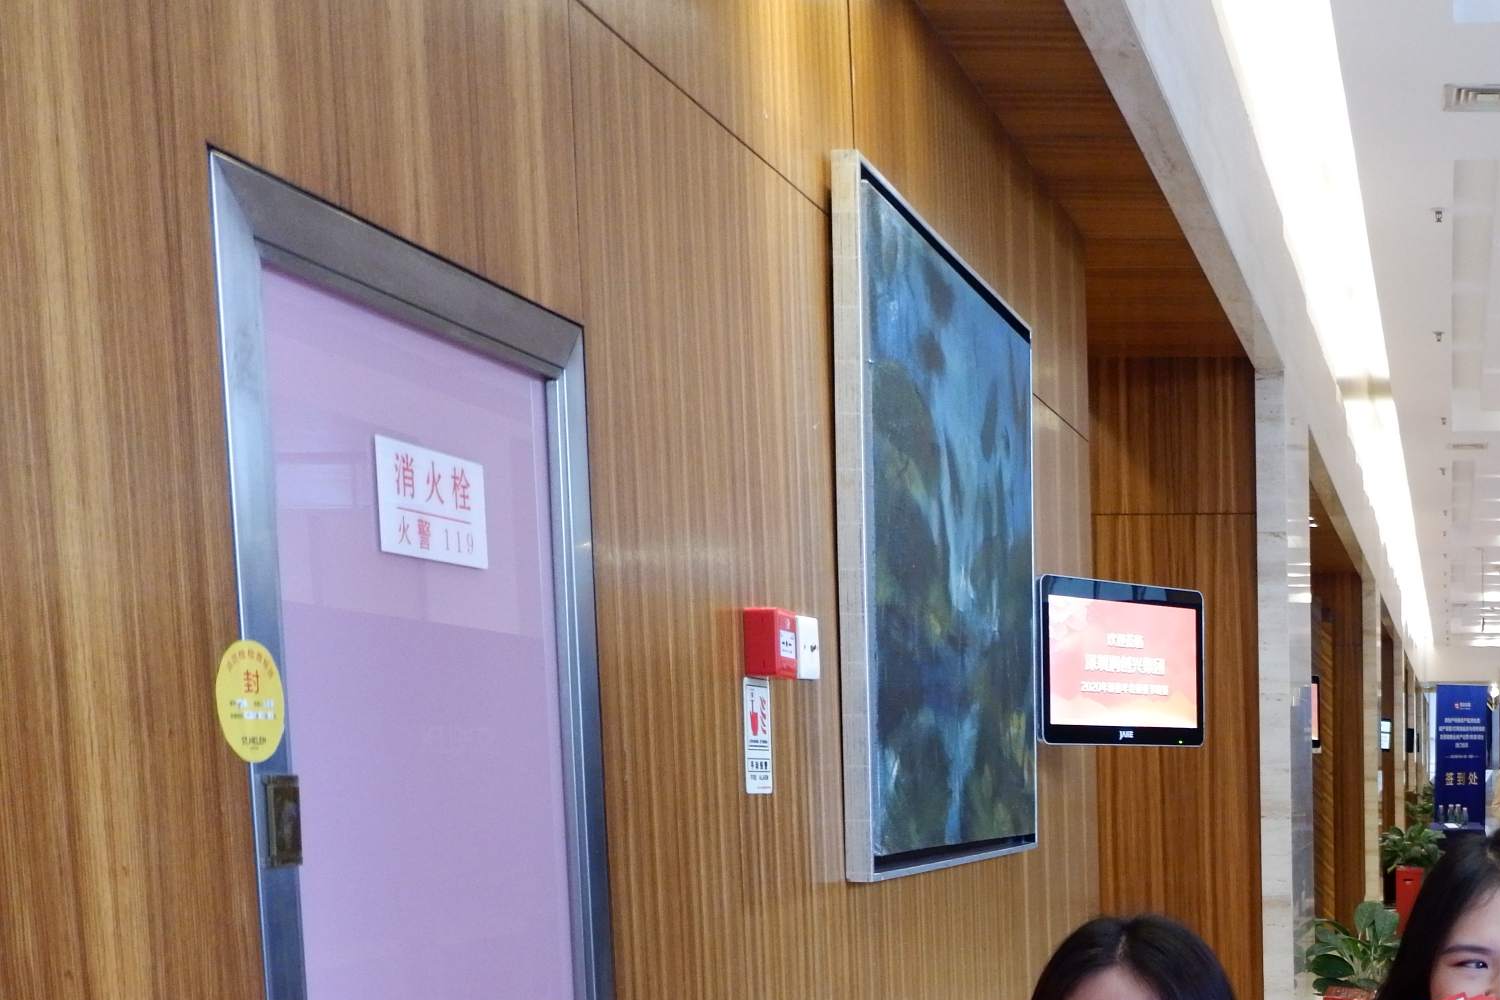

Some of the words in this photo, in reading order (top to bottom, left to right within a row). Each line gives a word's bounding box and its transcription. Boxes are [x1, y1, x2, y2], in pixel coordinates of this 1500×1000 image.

[394, 452, 471, 511] 消火栓
[398, 515, 431, 550] 火警
[443, 527, 474, 553] 119
[243, 669, 260, 695] 封
[1445, 772, 1479, 786] 签到处
